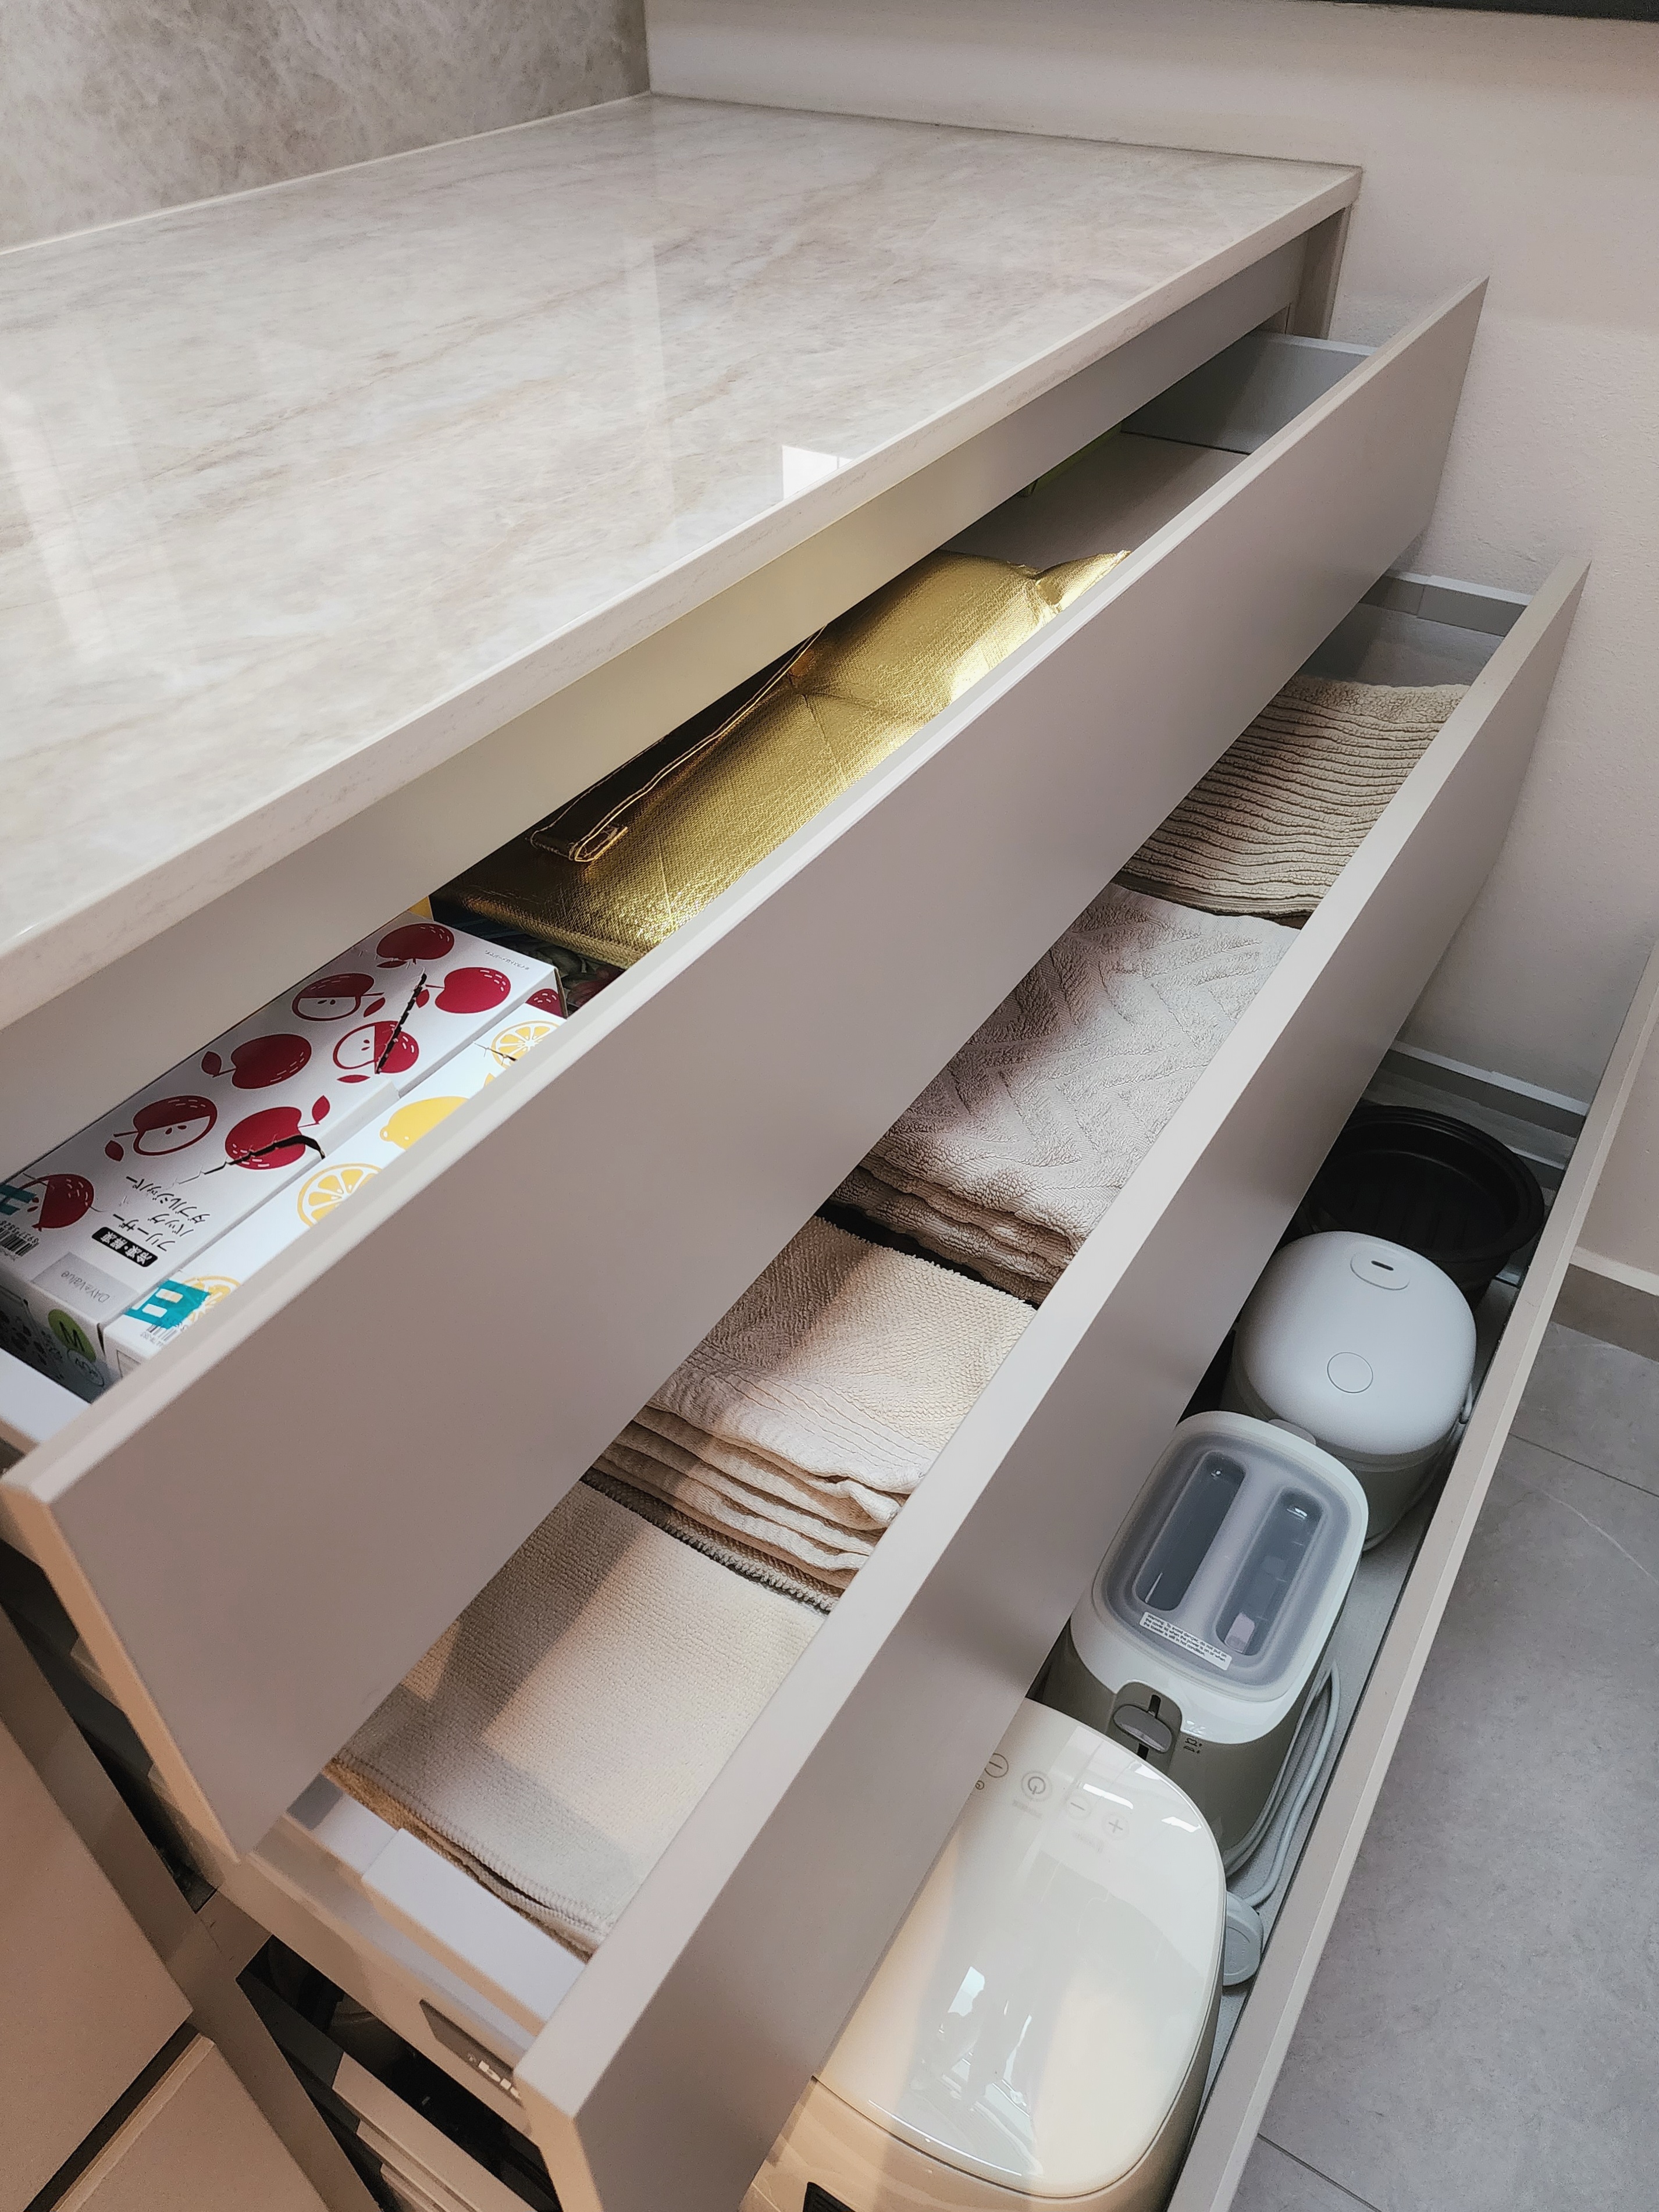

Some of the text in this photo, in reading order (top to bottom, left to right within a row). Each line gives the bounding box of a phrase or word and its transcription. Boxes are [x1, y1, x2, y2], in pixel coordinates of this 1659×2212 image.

[126, 1176, 210, 1224] ダブルジッパー
[113, 1213, 176, 1252] フリーザー
[148, 1213, 194, 1237] バッグ
